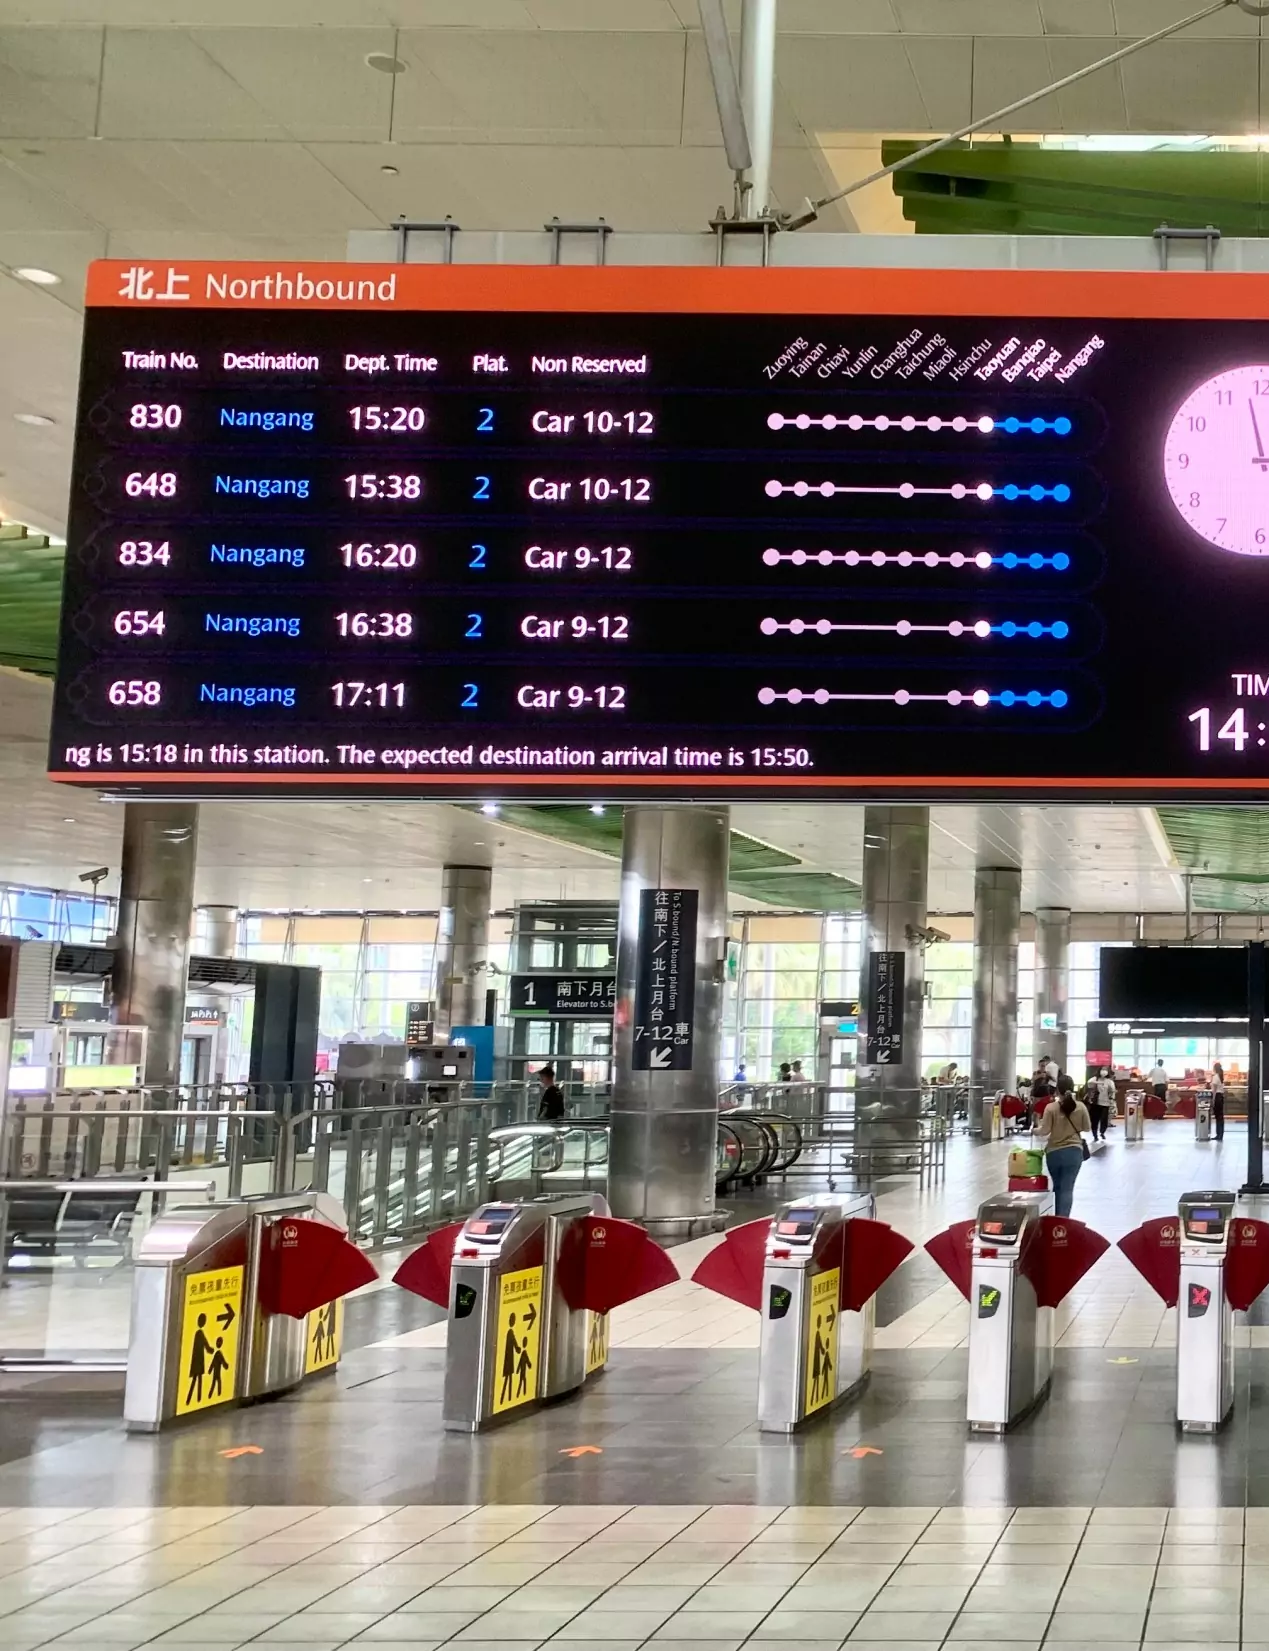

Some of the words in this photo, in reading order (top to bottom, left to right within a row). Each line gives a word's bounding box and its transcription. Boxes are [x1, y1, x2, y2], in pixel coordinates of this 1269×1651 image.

[118, 267, 190, 300] 北上
[206, 271, 396, 301] Northbound
[122, 350, 166, 369] Train
[170, 352, 198, 369] No.
[224, 352, 319, 370] Destination
[345, 354, 390, 374] Dept.
[394, 354, 438, 371] Time
[473, 354, 508, 372] Plat.
[532, 356, 567, 372] Non
[572, 355, 646, 373] Reserved
[763, 335, 809, 380] Zuoying
[789, 341, 828, 380] Tainan
[817, 345, 850, 380] Chiayi
[842, 344, 879, 381] Yunlin
[870, 328, 923, 381] Changhua
[895, 333, 946, 382] Taichung
[923, 346, 957, 381] Miaoli
[949, 338, 993, 382] Hsinchu
[974, 335, 1021, 383] Taoyuan
[1001, 337, 1046, 383] Banqiao
[1026, 346, 1063, 383] Taipei
[1054, 334, 1104, 383] Nangang
[130, 404, 181, 428] 830
[221, 409, 314, 431] Nangang
[350, 407, 424, 431] 15:20
[532, 411, 574, 433] Car
[583, 411, 653, 433] 10-12
[126, 472, 176, 497] 648
[216, 476, 309, 498] Nangang
[345, 475, 420, 498] 15:38
[529, 478, 571, 500] Car
[580, 478, 650, 500] 10-12
[119, 542, 170, 566] 834
[211, 544, 304, 567] Nangang
[341, 543, 416, 568] 16:20
[525, 546, 567, 569] Car
[575, 547, 631, 569] 9-12
[109, 681, 160, 705] 658
[201, 684, 295, 706] Nangang
[332, 683, 404, 706] 17:11
[518, 686, 561, 707] Car
[568, 686, 625, 708] 9-12
[97, 743, 112, 763] is
[120, 744, 177, 762] 15:18
[184, 744, 203, 764] in
[210, 744, 248, 763] this
[254, 745, 329, 764] station.
[337, 745, 376, 764] The
[380, 745, 473, 768] expected
[479, 745, 595, 765] destination
[601, 746, 667, 765] arrival
[674, 747, 722, 766] time
[728, 747, 744, 766] is
[751, 748, 813, 766] 15:50.
[672, 892, 682, 901] To
[524, 982, 536, 1005] 1
[557, 981, 617, 996] 南下月台
[669, 976, 678, 1011] platform
[557, 1000, 588, 1008] Elevator
[590, 1000, 598, 1008] to
[635, 1026, 673, 1042] 7-12
[675, 1022, 689, 1036] 車
[673, 1037, 689, 1045] Car
[867, 1036, 891, 1046] 7-12
